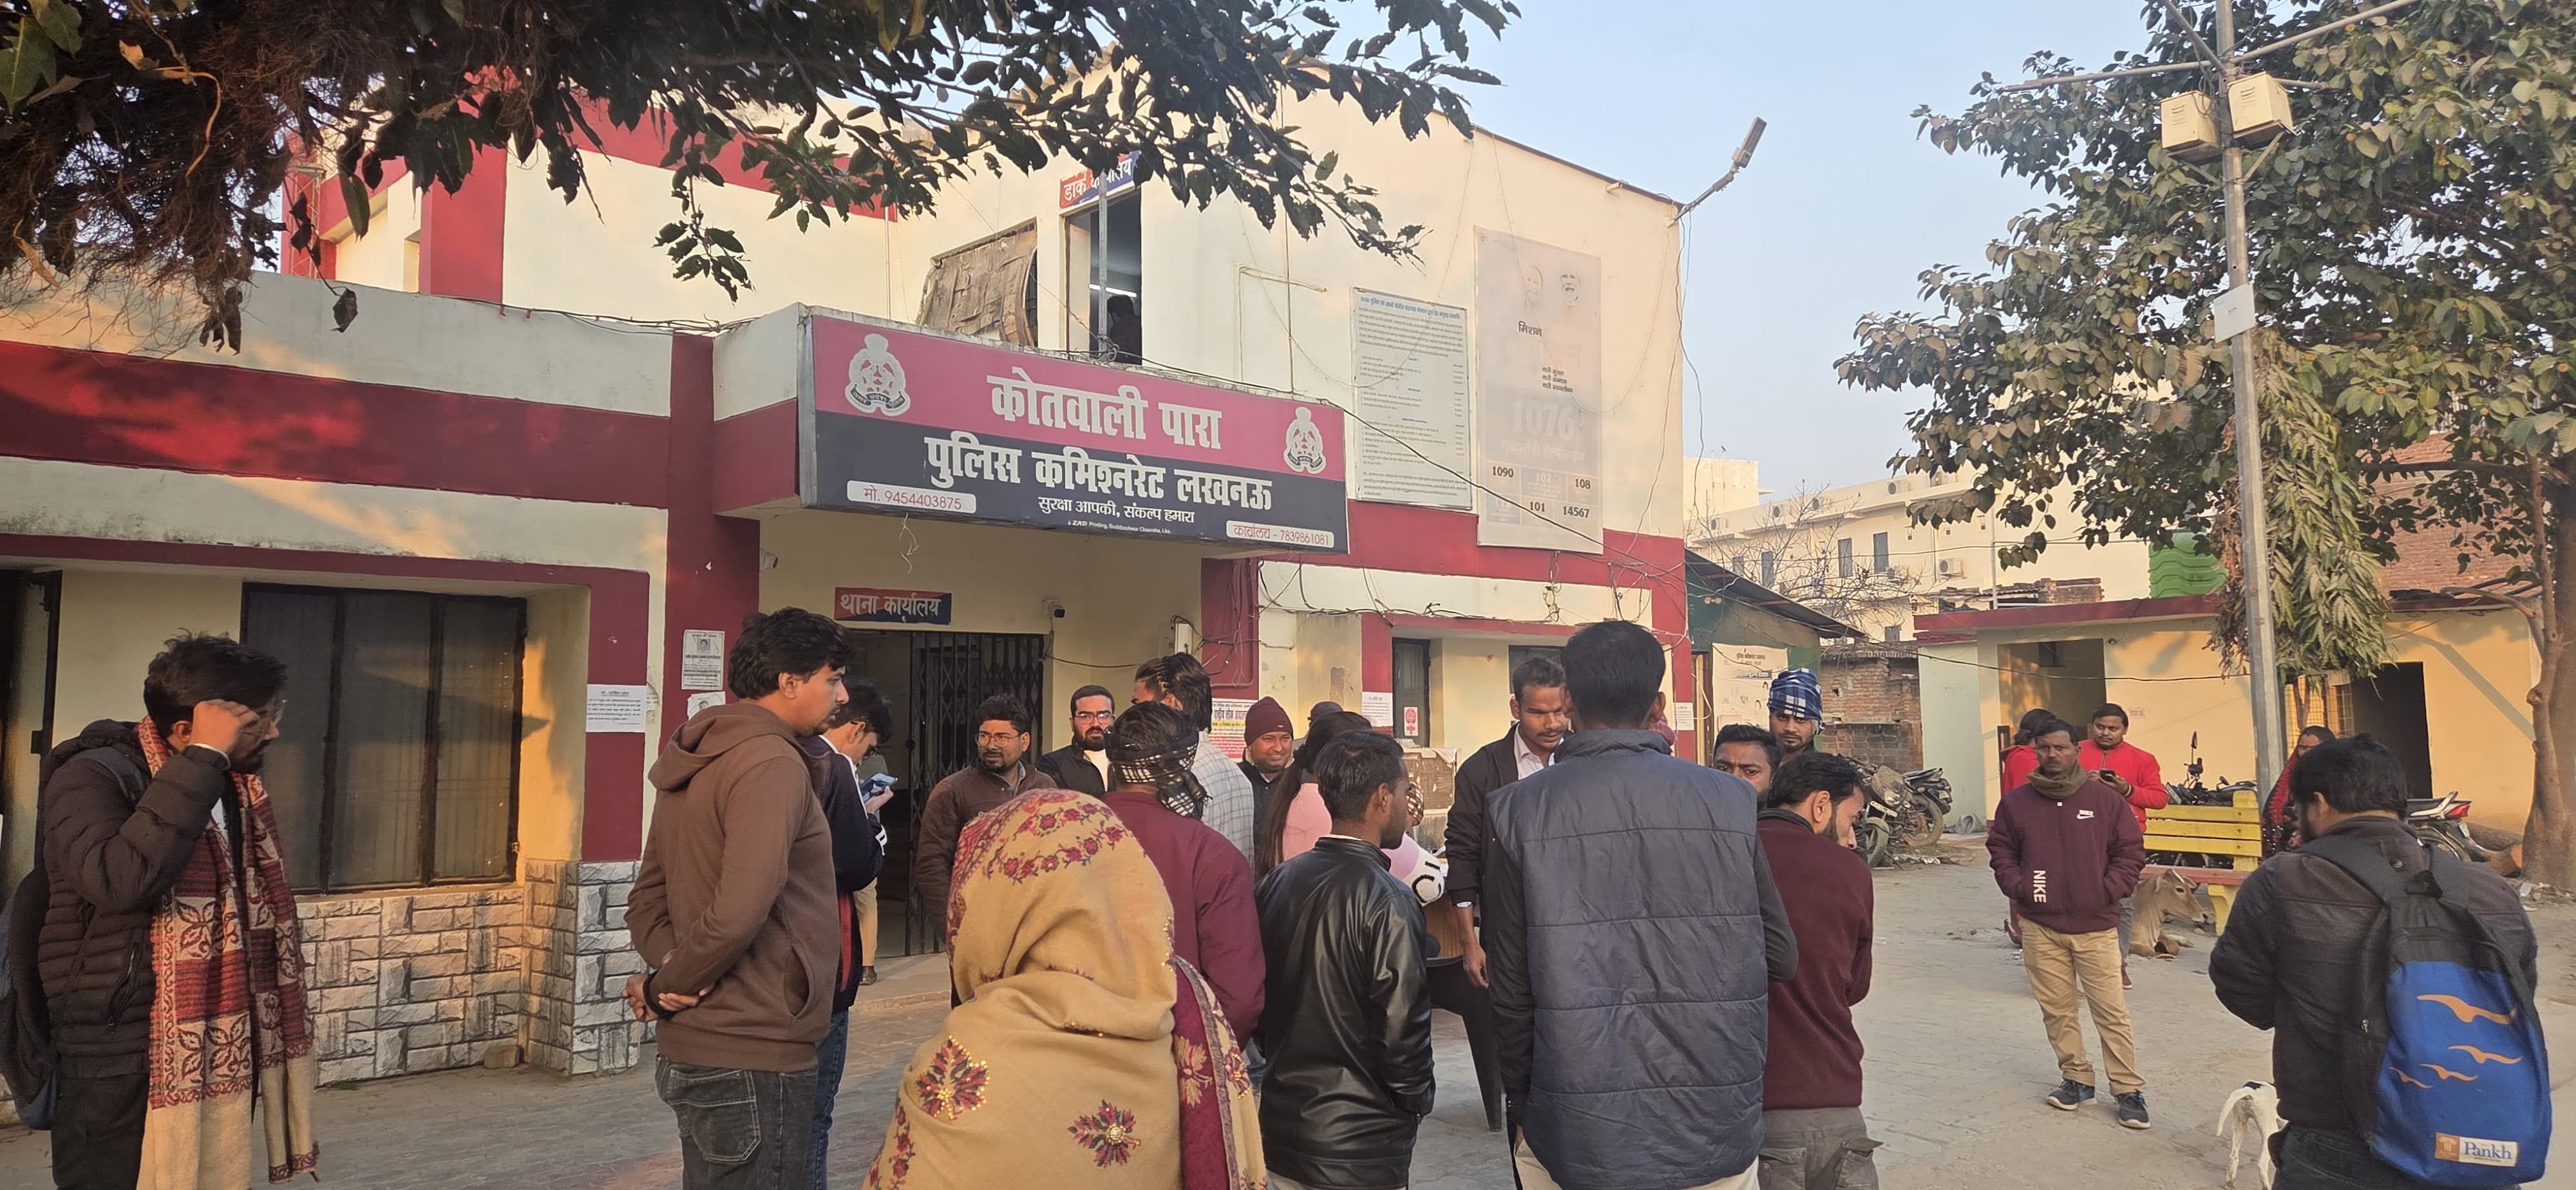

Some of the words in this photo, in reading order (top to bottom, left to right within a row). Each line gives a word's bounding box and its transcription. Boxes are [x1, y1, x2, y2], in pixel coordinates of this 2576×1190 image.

[1064, 178, 1086, 201] डाक
[1518, 321, 1542, 337] मिशन
[987, 366, 1149, 439] कोतवाली
[1158, 402, 1222, 449] पारा
[1512, 397, 1575, 440] 1076
[924, 431, 1022, 488] पुलिस
[1031, 446, 1166, 498] कमिश्नरेट
[1173, 469, 1273, 510] लखनऊ
[1492, 466, 1514, 478] 1090
[1535, 472, 1551, 483] 102
[1575, 478, 1591, 489] 108
[884, 490, 962, 510] 9454403875
[1530, 501, 1546, 513] 101
[1037, 496, 1073, 515] सुरक्षा
[1075, 500, 1121, 518] आपकी,
[1124, 502, 1162, 520] संकल्प
[1164, 509, 1195, 524] हमारा
[1563, 505, 1590, 518] 14567
[1280, 530, 1329, 545] 7839861081
[840, 594, 880, 615] थाना
[884, 592, 942, 617] कार्यालय
[2033, 870, 2047, 903] NIKE
[2464, 1141, 2512, 1160] Pankh
